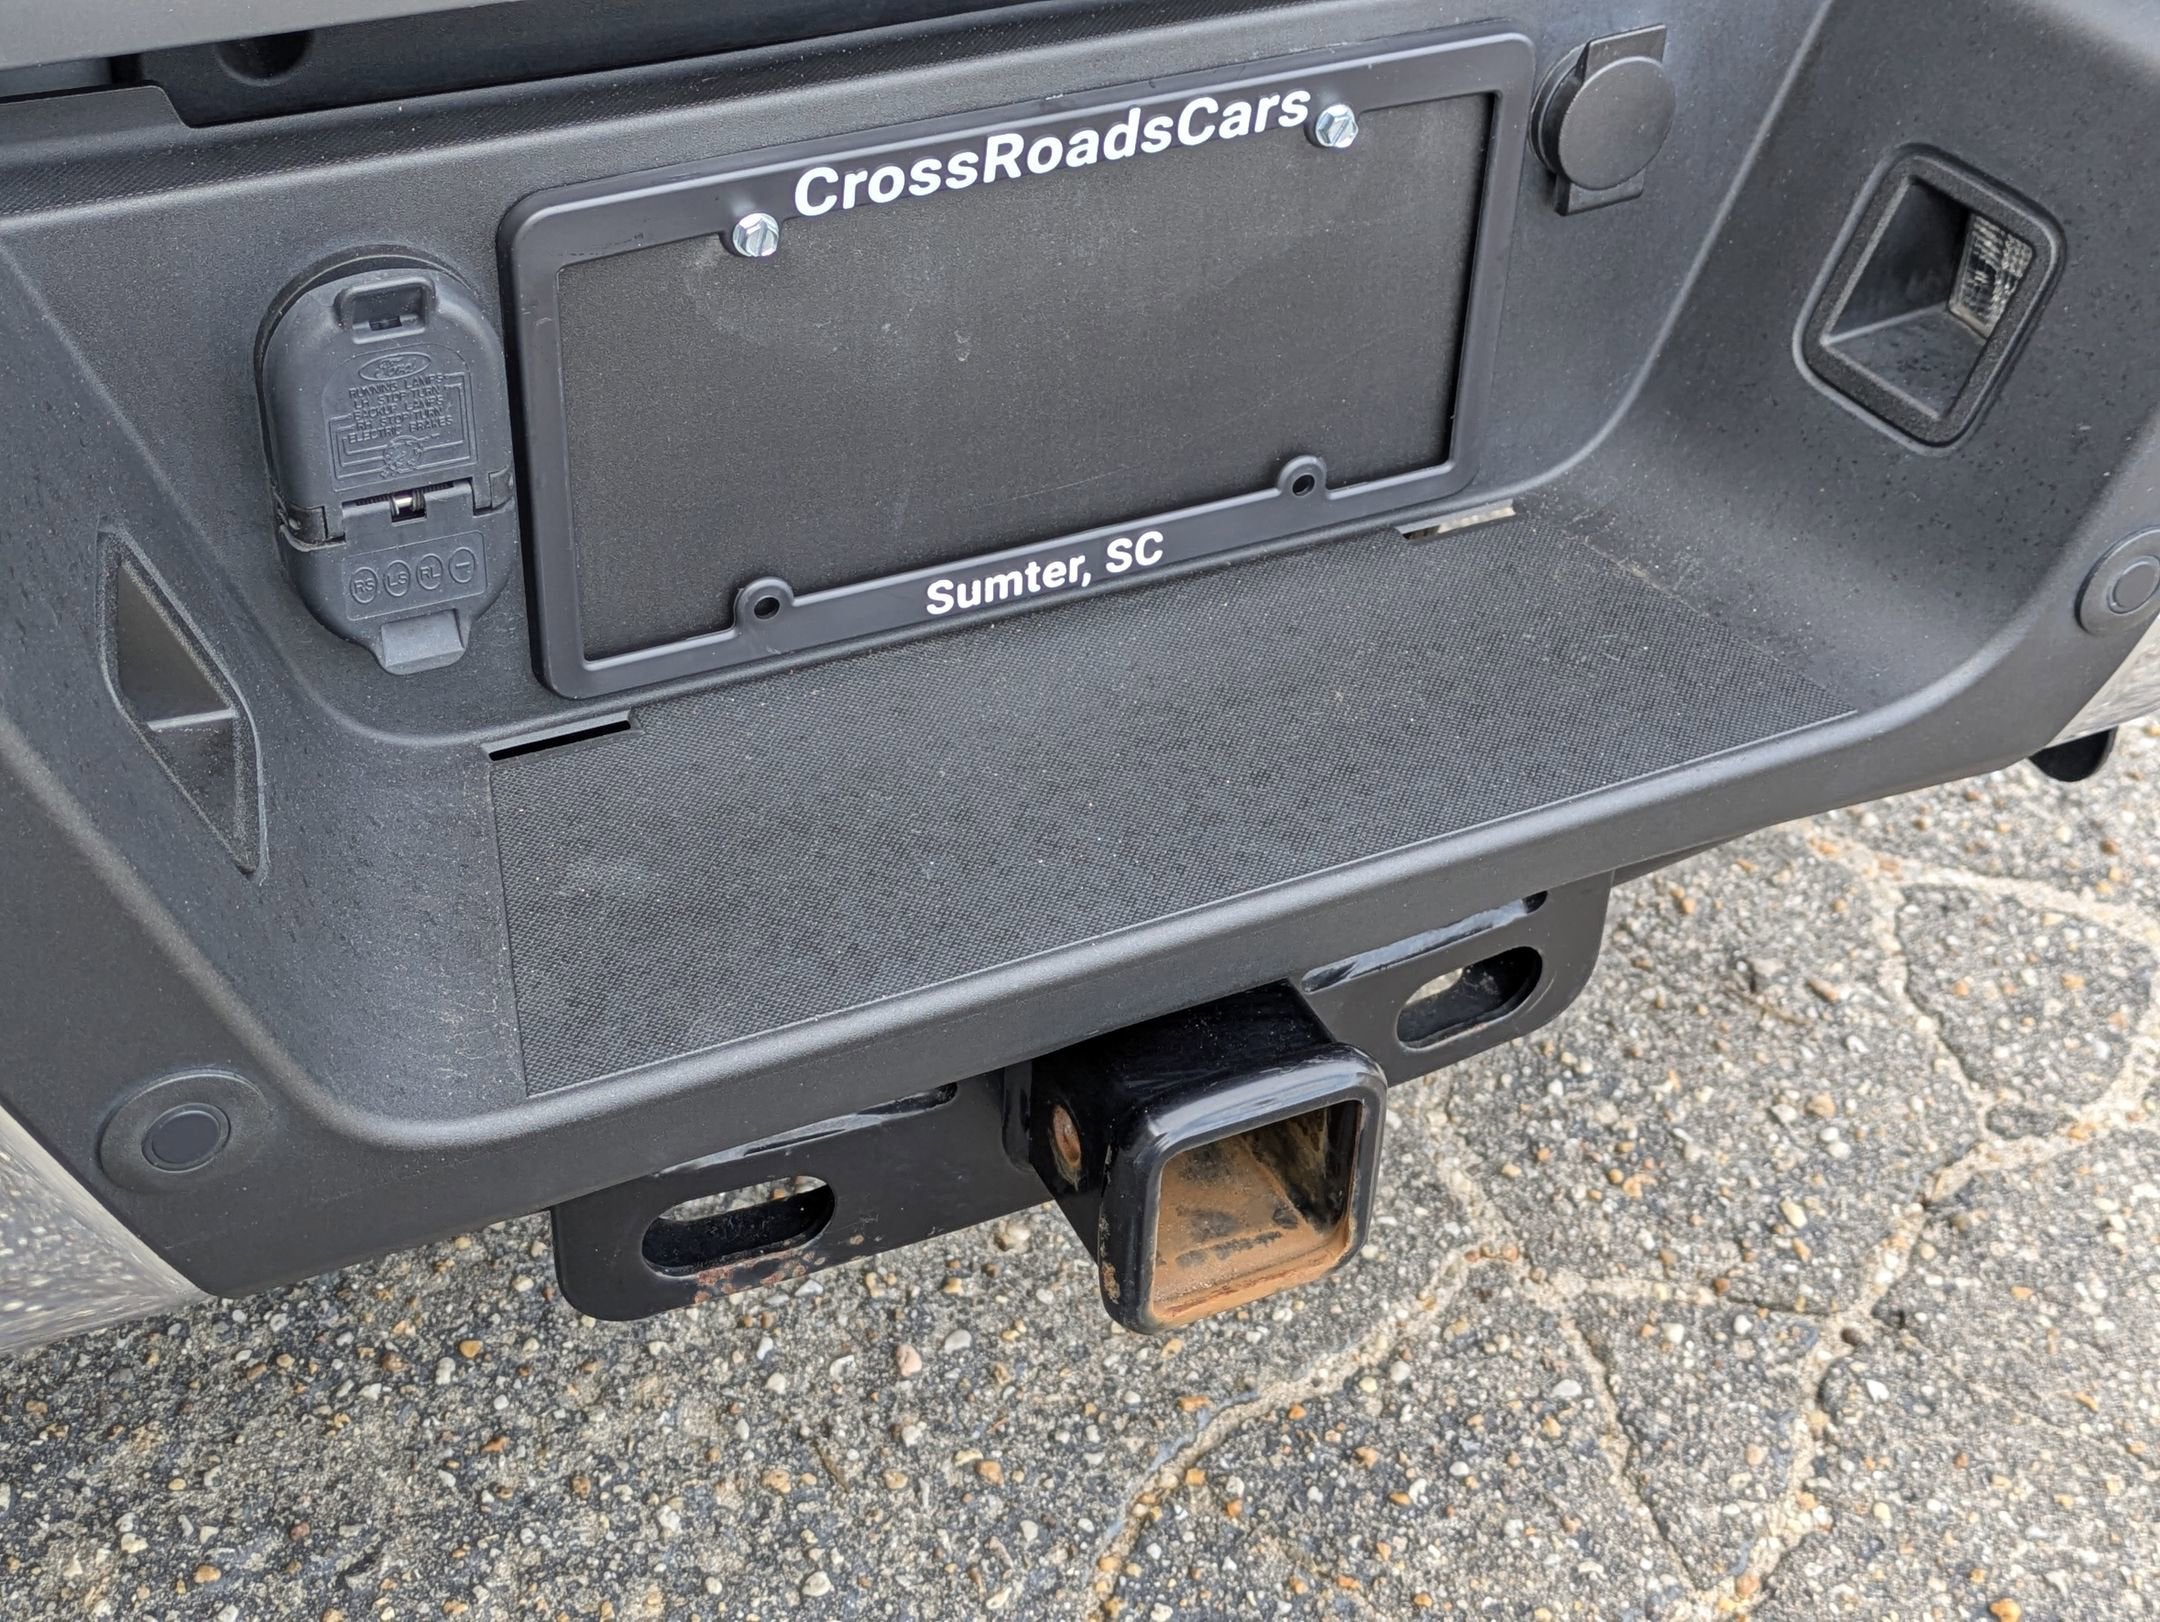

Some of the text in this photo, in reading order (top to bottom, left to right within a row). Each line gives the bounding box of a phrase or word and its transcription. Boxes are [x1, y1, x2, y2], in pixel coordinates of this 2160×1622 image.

[794, 90, 1311, 216] CrossRoadsCars
[348, 372, 444, 399] RUNNING LAMPS
[353, 394, 444, 421] BACKUP LAMPS
[347, 414, 454, 444] ELECTRIC BRAKES
[354, 577, 375, 594] RS
[386, 570, 408, 587] LS
[420, 565, 441, 581] RL
[926, 530, 1164, 615] Sumter, SC
